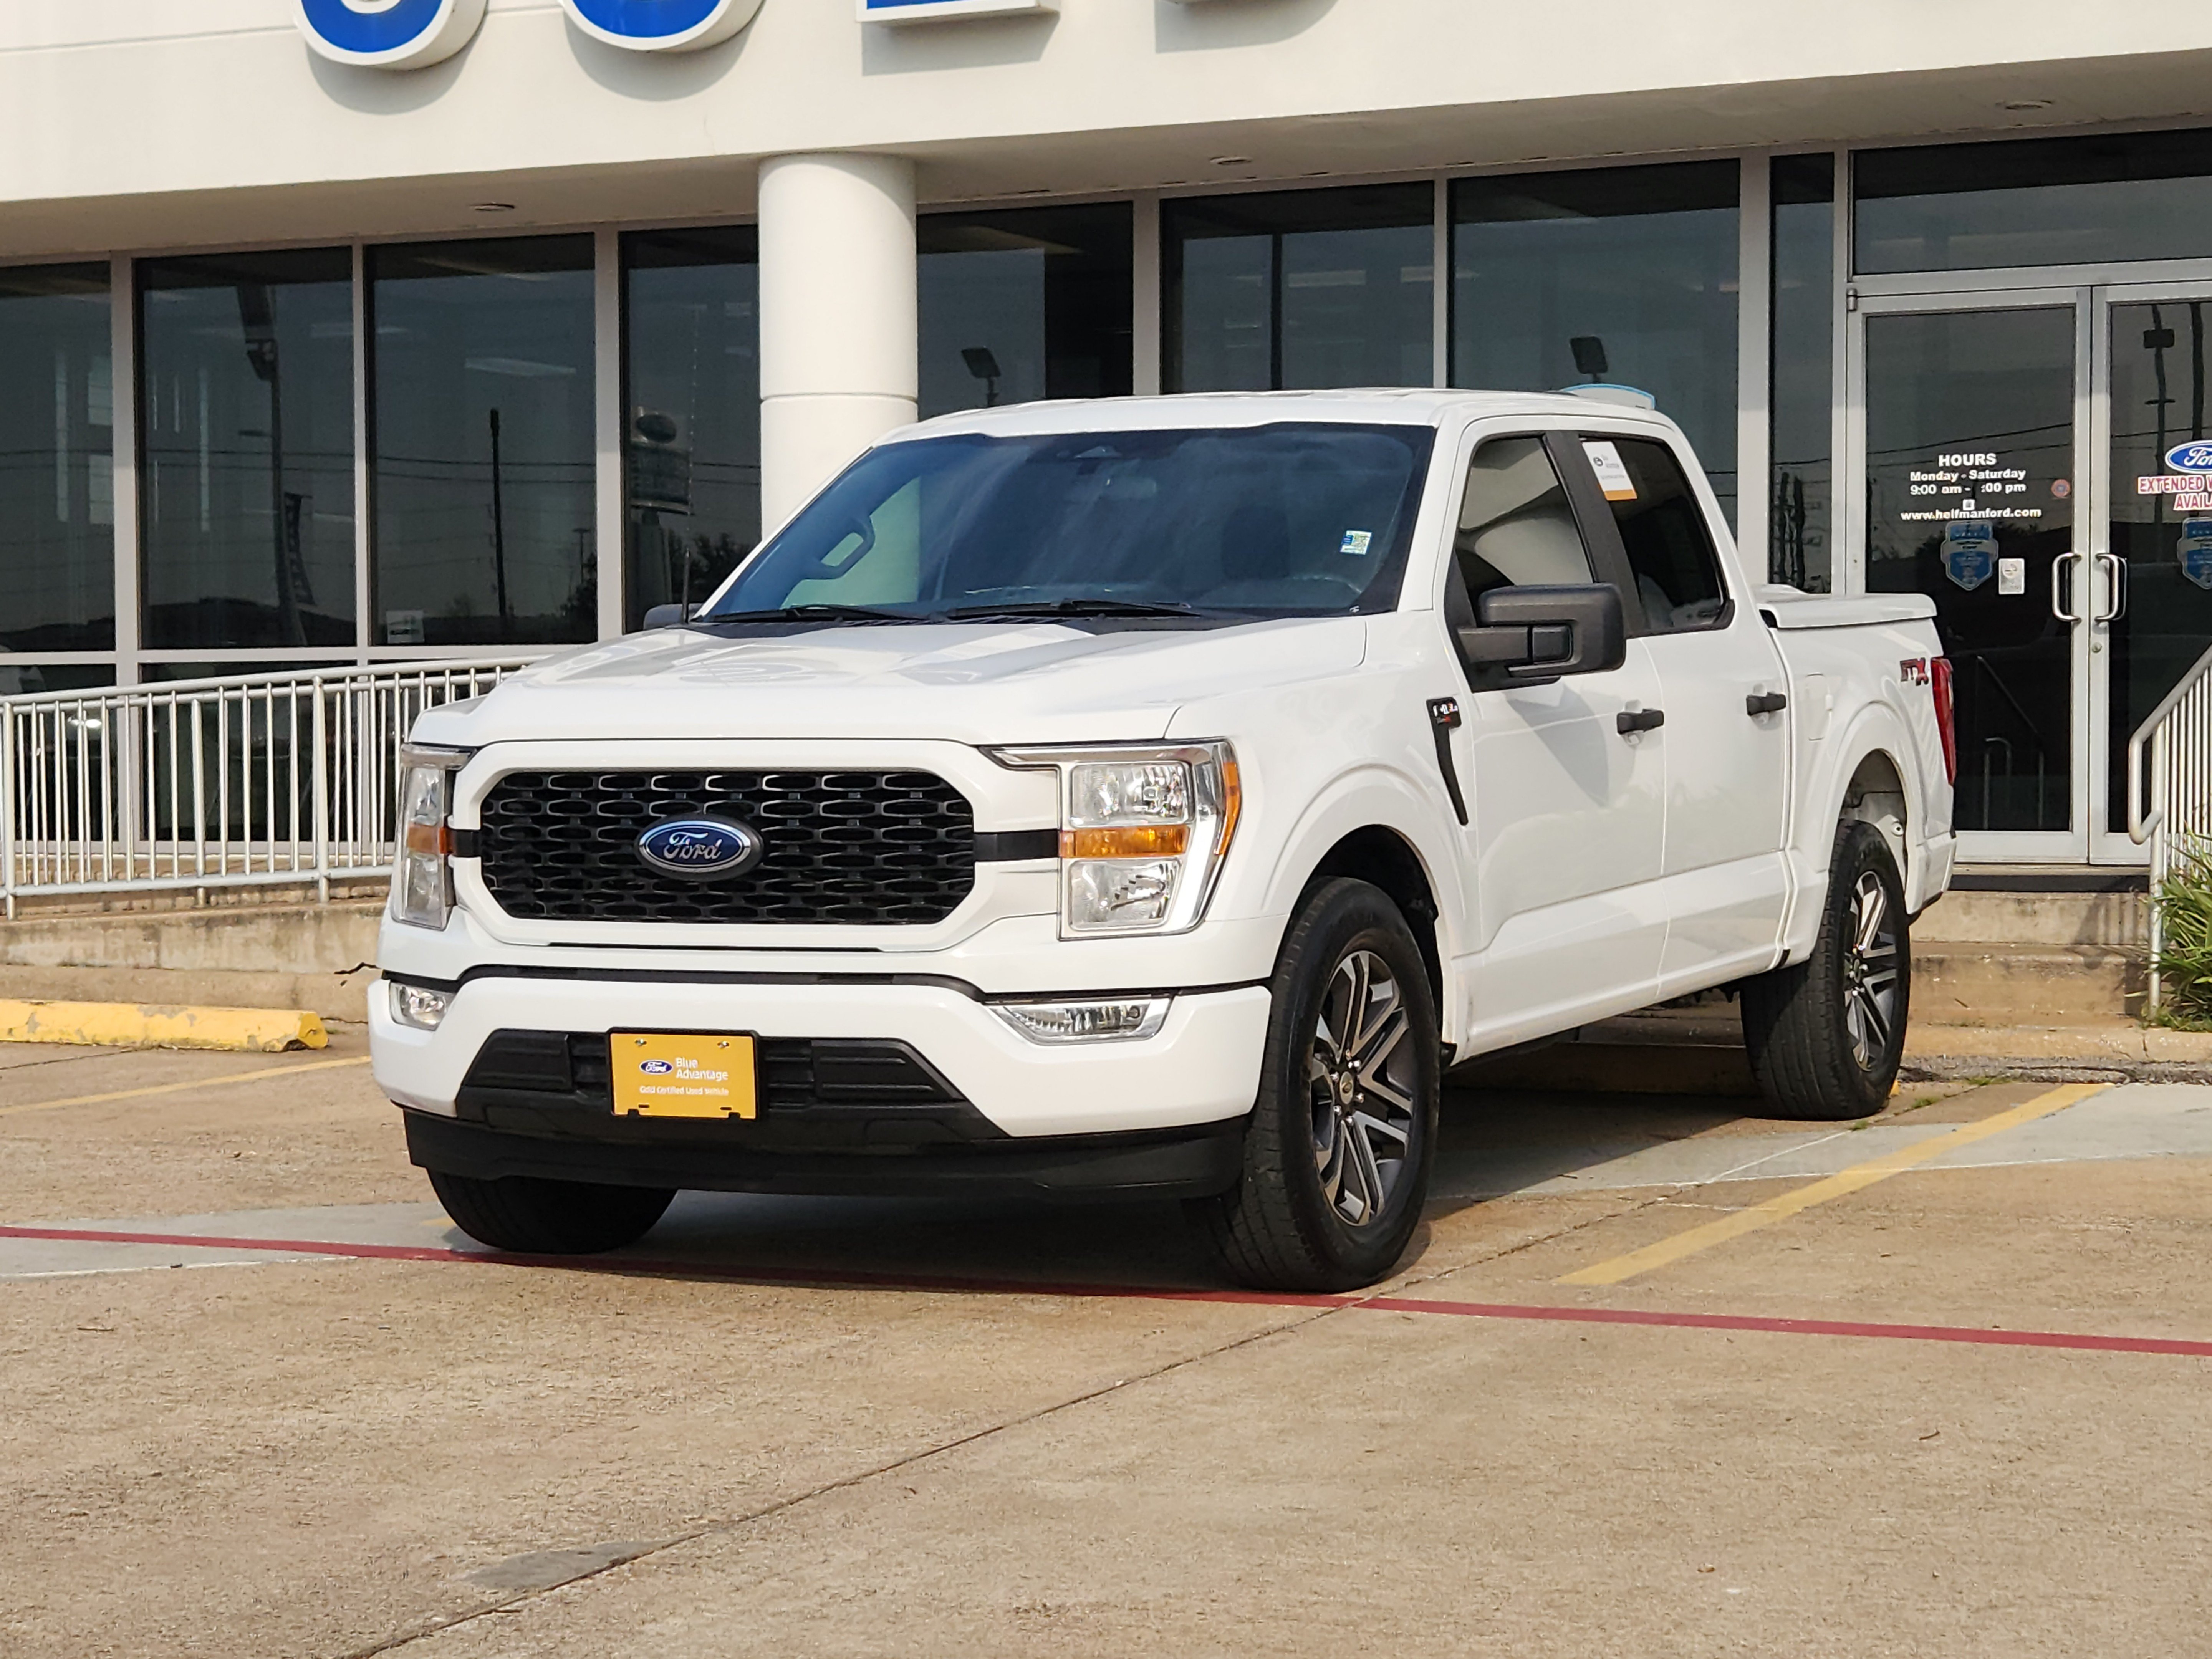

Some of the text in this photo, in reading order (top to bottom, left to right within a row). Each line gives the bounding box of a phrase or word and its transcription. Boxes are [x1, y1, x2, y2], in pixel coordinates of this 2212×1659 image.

[1938, 453, 1997, 467] HOURS
[1910, 471, 1959, 482] Monday
[1969, 469, 2026, 480] Saturday
[1910, 484, 1937, 495] 9:00
[1941, 485, 1962, 494] am
[2005, 484, 2027, 494] pm
[2139, 476, 2204, 493] EXTENDED
[663, 831, 722, 859] Ford
[646, 1061, 667, 1071] Ford
[676, 1057, 698, 1068] Blue
[676, 1069, 729, 1082] Advantage
